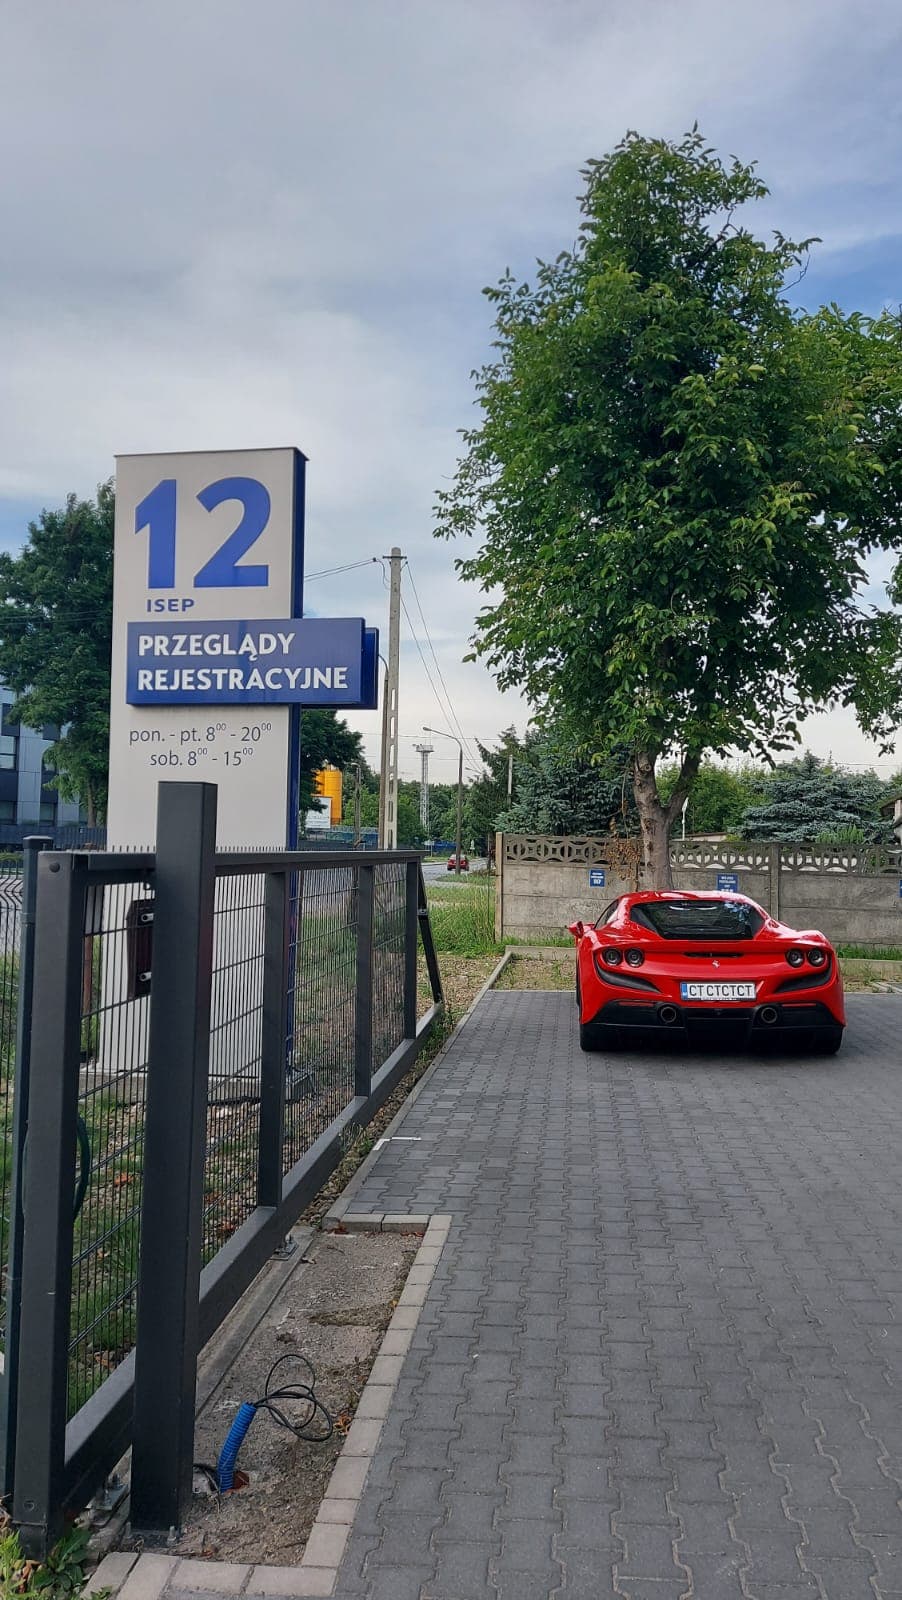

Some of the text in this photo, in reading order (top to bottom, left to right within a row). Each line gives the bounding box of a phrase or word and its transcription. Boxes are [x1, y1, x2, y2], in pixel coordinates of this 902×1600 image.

[134, 476, 271, 589] 12
[147, 598, 195, 613] ISEP
[138, 633, 296, 662] PRZEGLĄDY
[137, 666, 349, 691] REJESTRACYJNE
[129, 729, 165, 746] pon.
[180, 728, 201, 745] pt.
[150, 750, 183, 766] sob.
